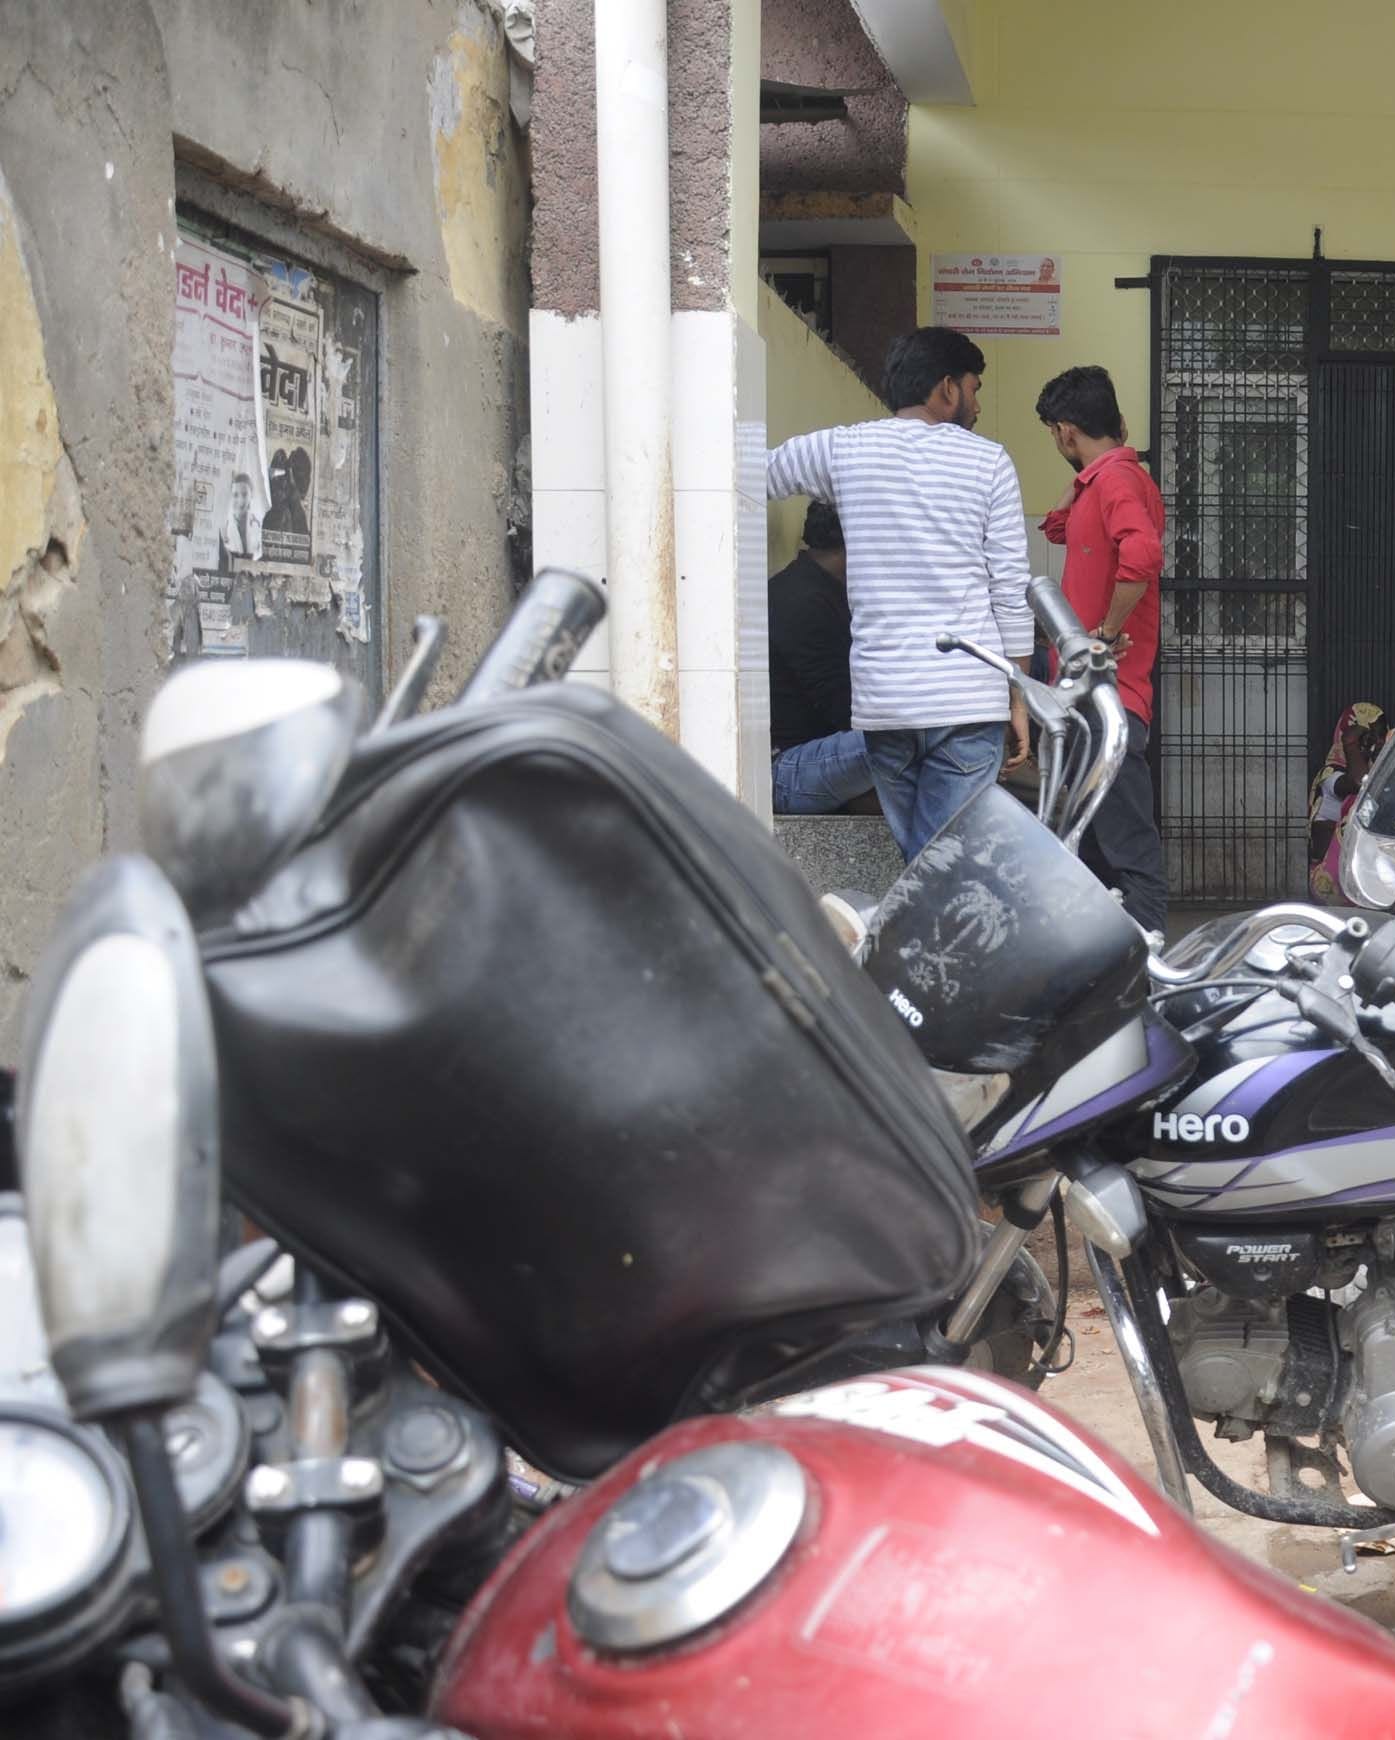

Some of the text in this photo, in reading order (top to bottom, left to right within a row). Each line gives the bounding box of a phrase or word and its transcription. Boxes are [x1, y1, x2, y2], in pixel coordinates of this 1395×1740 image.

[888, 988, 924, 1028] Hero
[1153, 1112, 1250, 1143] Hero
[1226, 1244, 1292, 1255] POWER
[1238, 1253, 1301, 1263] START
